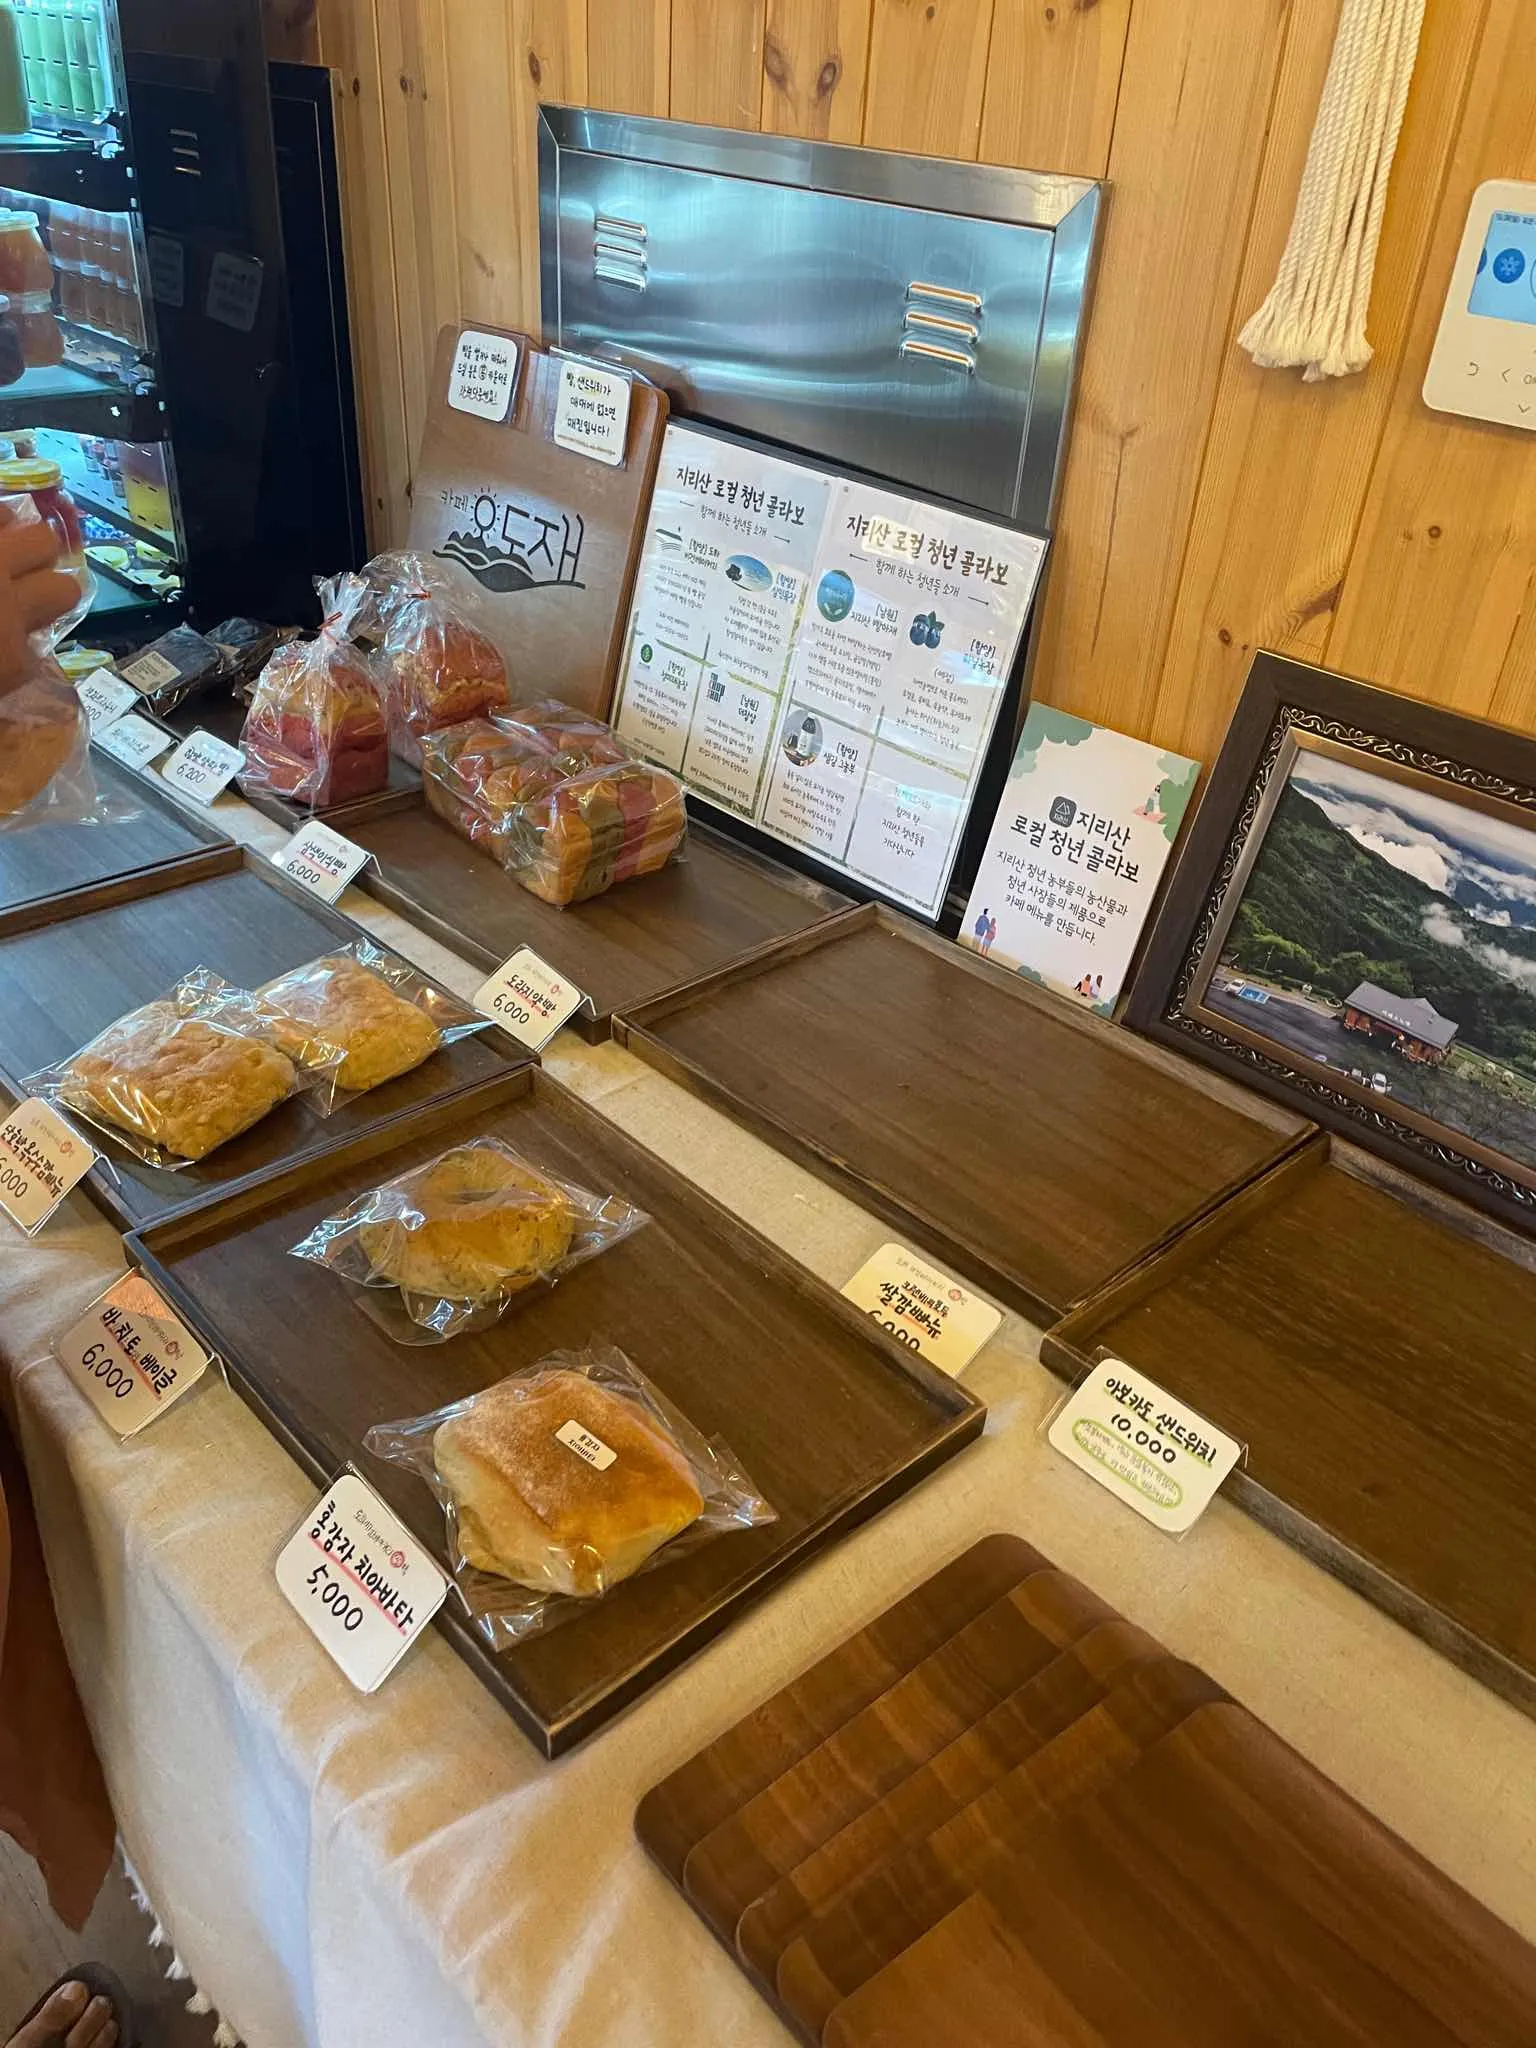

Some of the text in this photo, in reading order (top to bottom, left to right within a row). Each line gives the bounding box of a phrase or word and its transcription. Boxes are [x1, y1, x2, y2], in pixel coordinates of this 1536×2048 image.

[676, 465, 804, 525] 지리산 로컬 청년 콜라보
[846, 514, 1008, 586] 지리산 로컬 청년 콜라보
[875, 558, 960, 597] 함께 하는 청년들 소개
[176, 763, 207, 784] 6,200
[882, 818, 900, 834] 지리산
[1010, 815, 1140, 883] 로컬 청년 콜라보
[1076, 811, 1131, 853] 지리산
[286, 860, 321, 884] 6,000
[997, 851, 1129, 916] 지리산 청년 농부들의 농산물과
[1005, 894, 1097, 946] 카페 메뉴를 만듭니다.
[1007, 876, 1107, 928] 청년 사장들의 제품으로
[493, 992, 530, 1024] 6,000
[81, 1342, 134, 1398] 6,000
[139, 1352, 178, 1392] 베이글
[1105, 1377, 1154, 1423] 아보카도
[1155, 1413, 1218, 1464] 샌드위치
[1111, 1414, 1177, 1464] 10,000
[311, 1500, 356, 1563] 홍감자
[354, 1554, 414, 1628] 치아바타
[306, 1563, 364, 1631] 5,000
